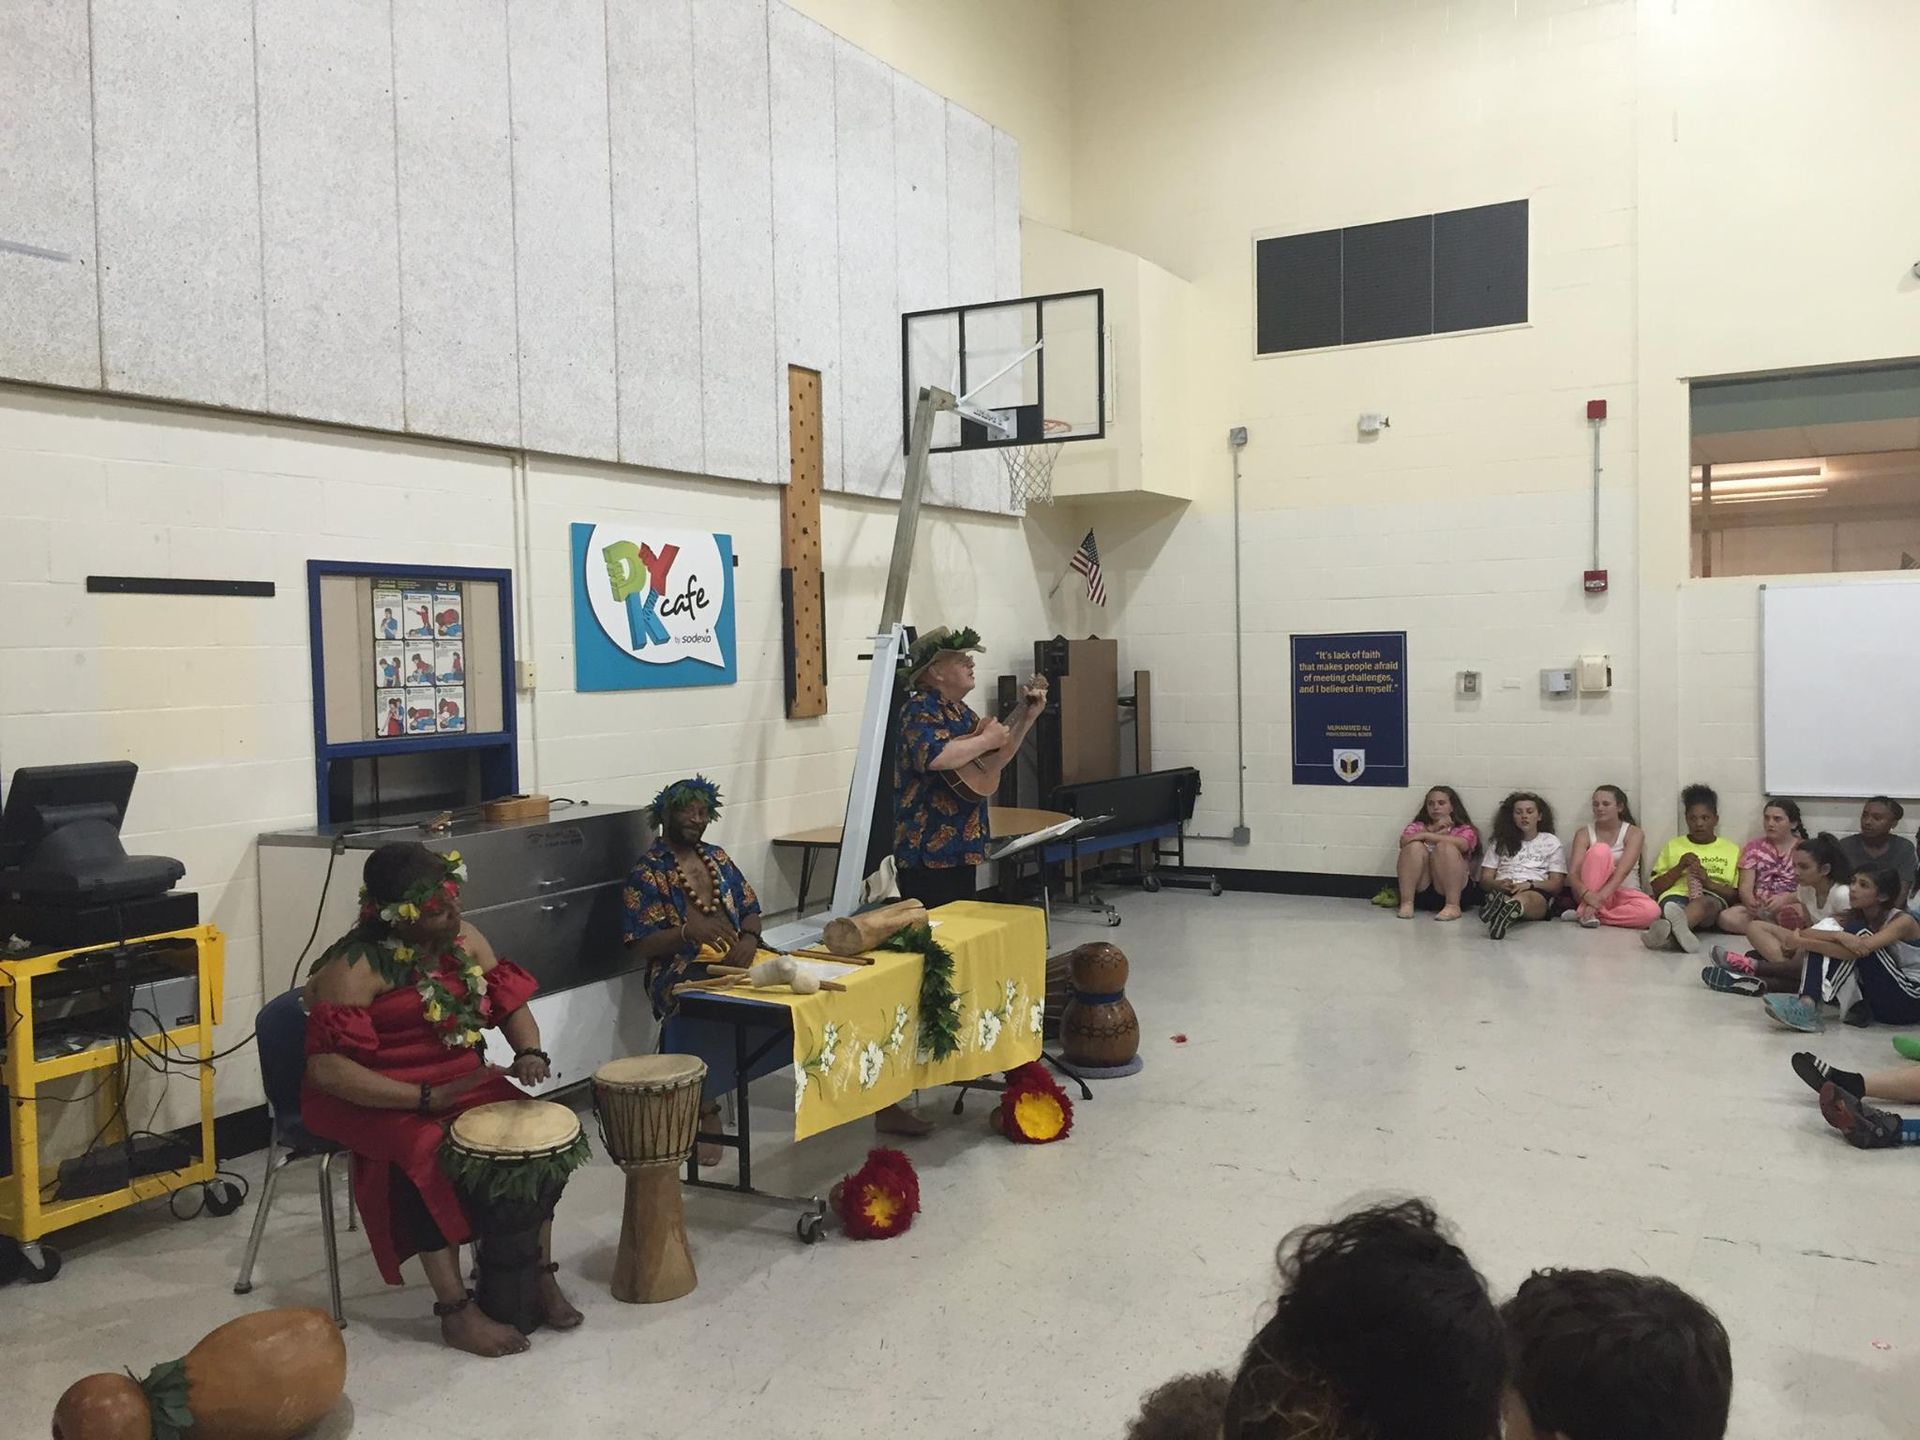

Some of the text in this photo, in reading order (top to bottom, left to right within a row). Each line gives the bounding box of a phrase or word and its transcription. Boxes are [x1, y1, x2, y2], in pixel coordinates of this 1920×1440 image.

[660, 574, 710, 621] cafe
[1333, 650, 1351, 660] lack
[1352, 650, 1360, 660] of
[1361, 650, 1380, 659] faith
[1299, 661, 1398, 672] that makes people afraid
[1303, 673, 1394, 683] of meeting challenges,
[1299, 685, 1314, 694] and
[1320, 685, 1354, 693] believed
[1355, 685, 1364, 693] in
